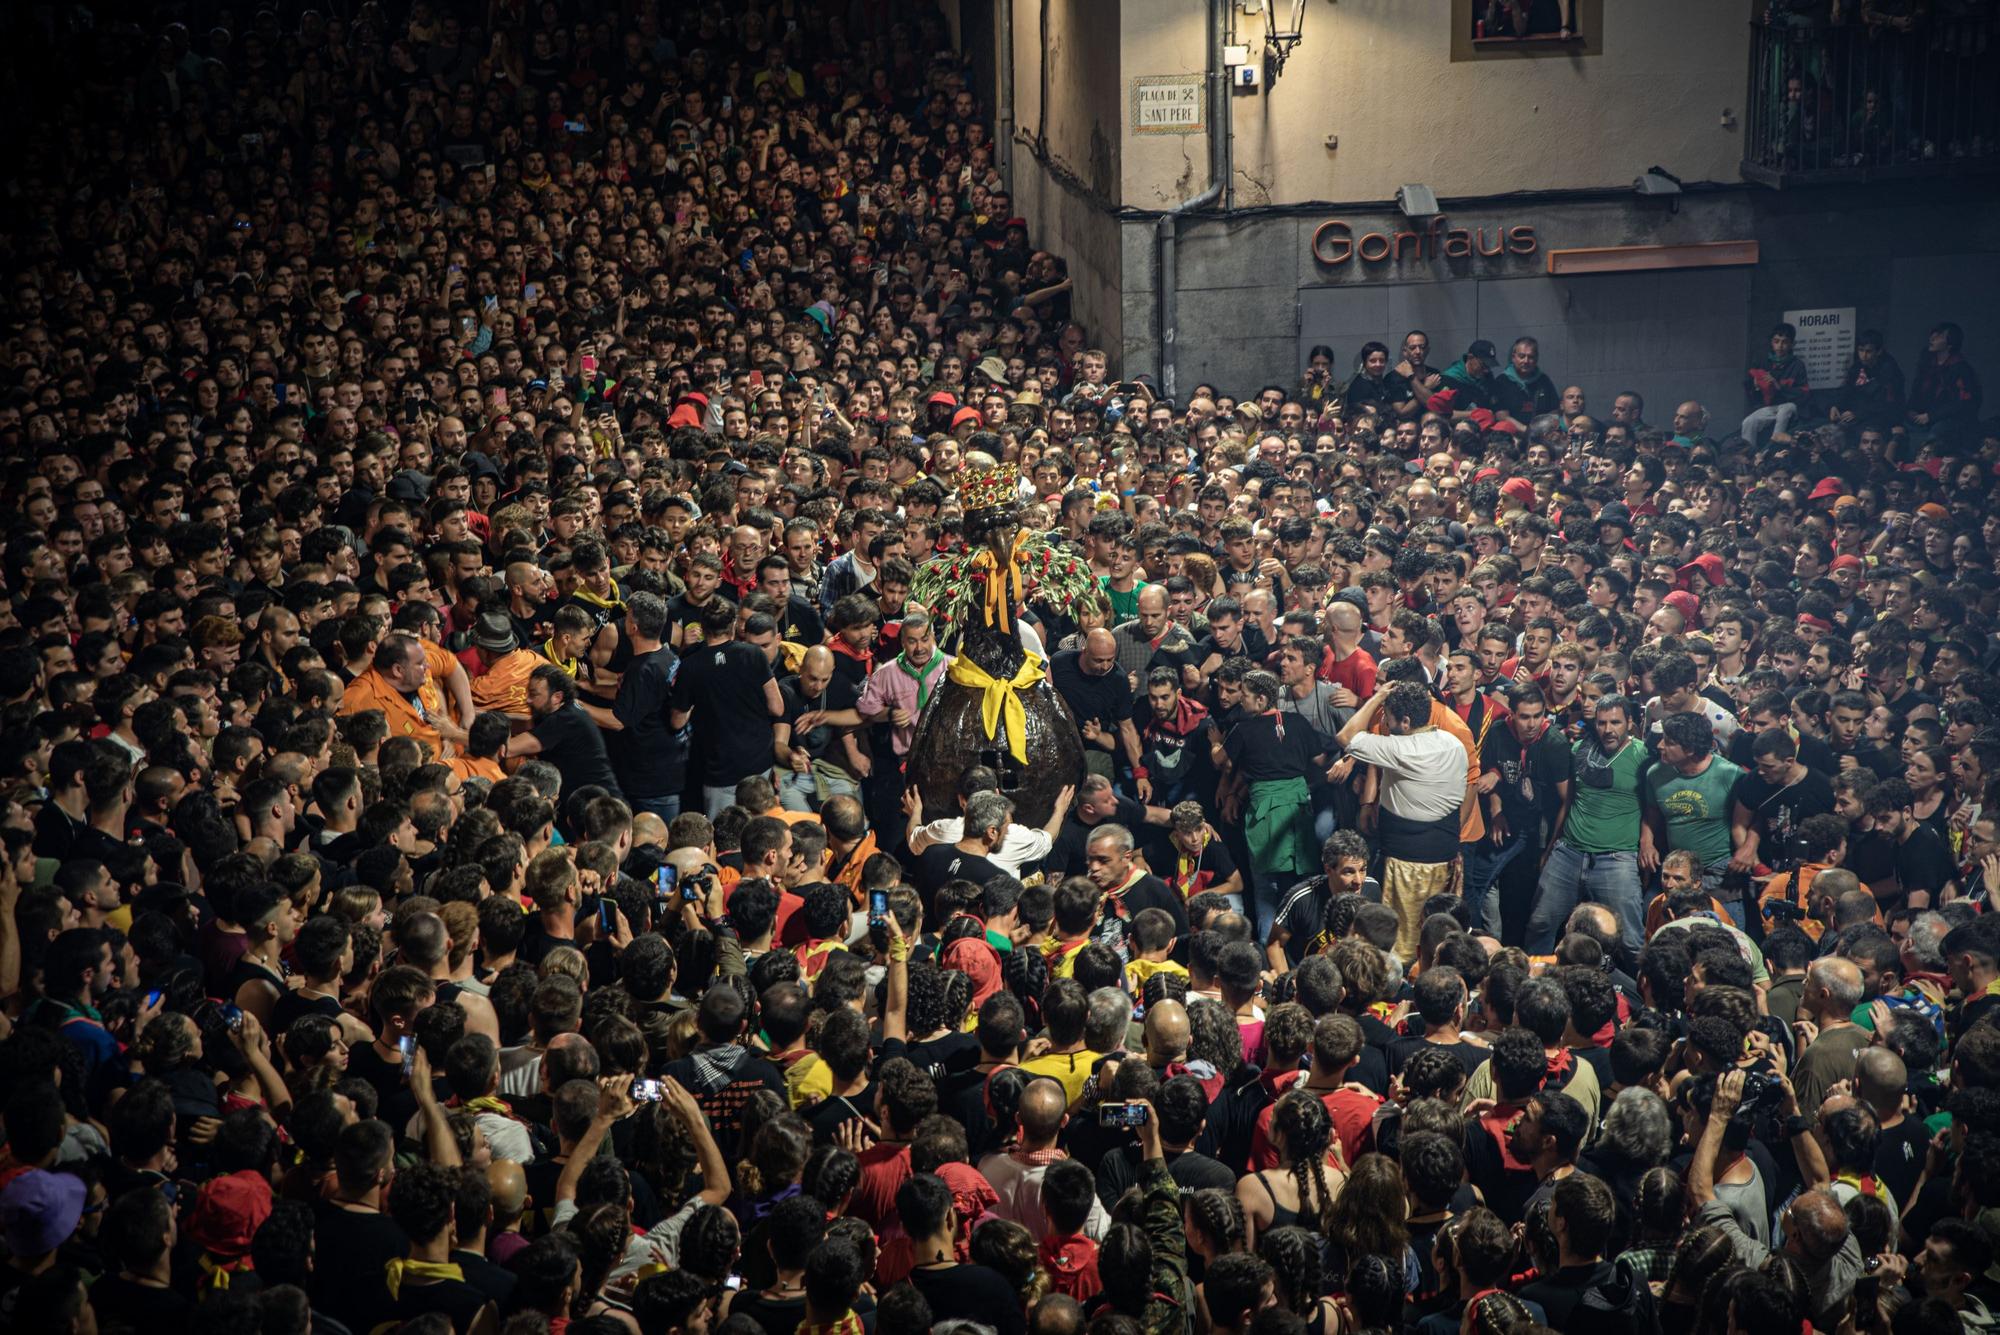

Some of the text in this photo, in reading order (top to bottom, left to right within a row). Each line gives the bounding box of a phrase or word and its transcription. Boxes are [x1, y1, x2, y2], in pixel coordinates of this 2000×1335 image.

[1140, 90, 1177, 103] PLAÇA DE
[1144, 108, 1193, 123] SANT PERE
[1312, 214, 1537, 264] Gonfaus
[1799, 314, 1840, 327] HORARI
